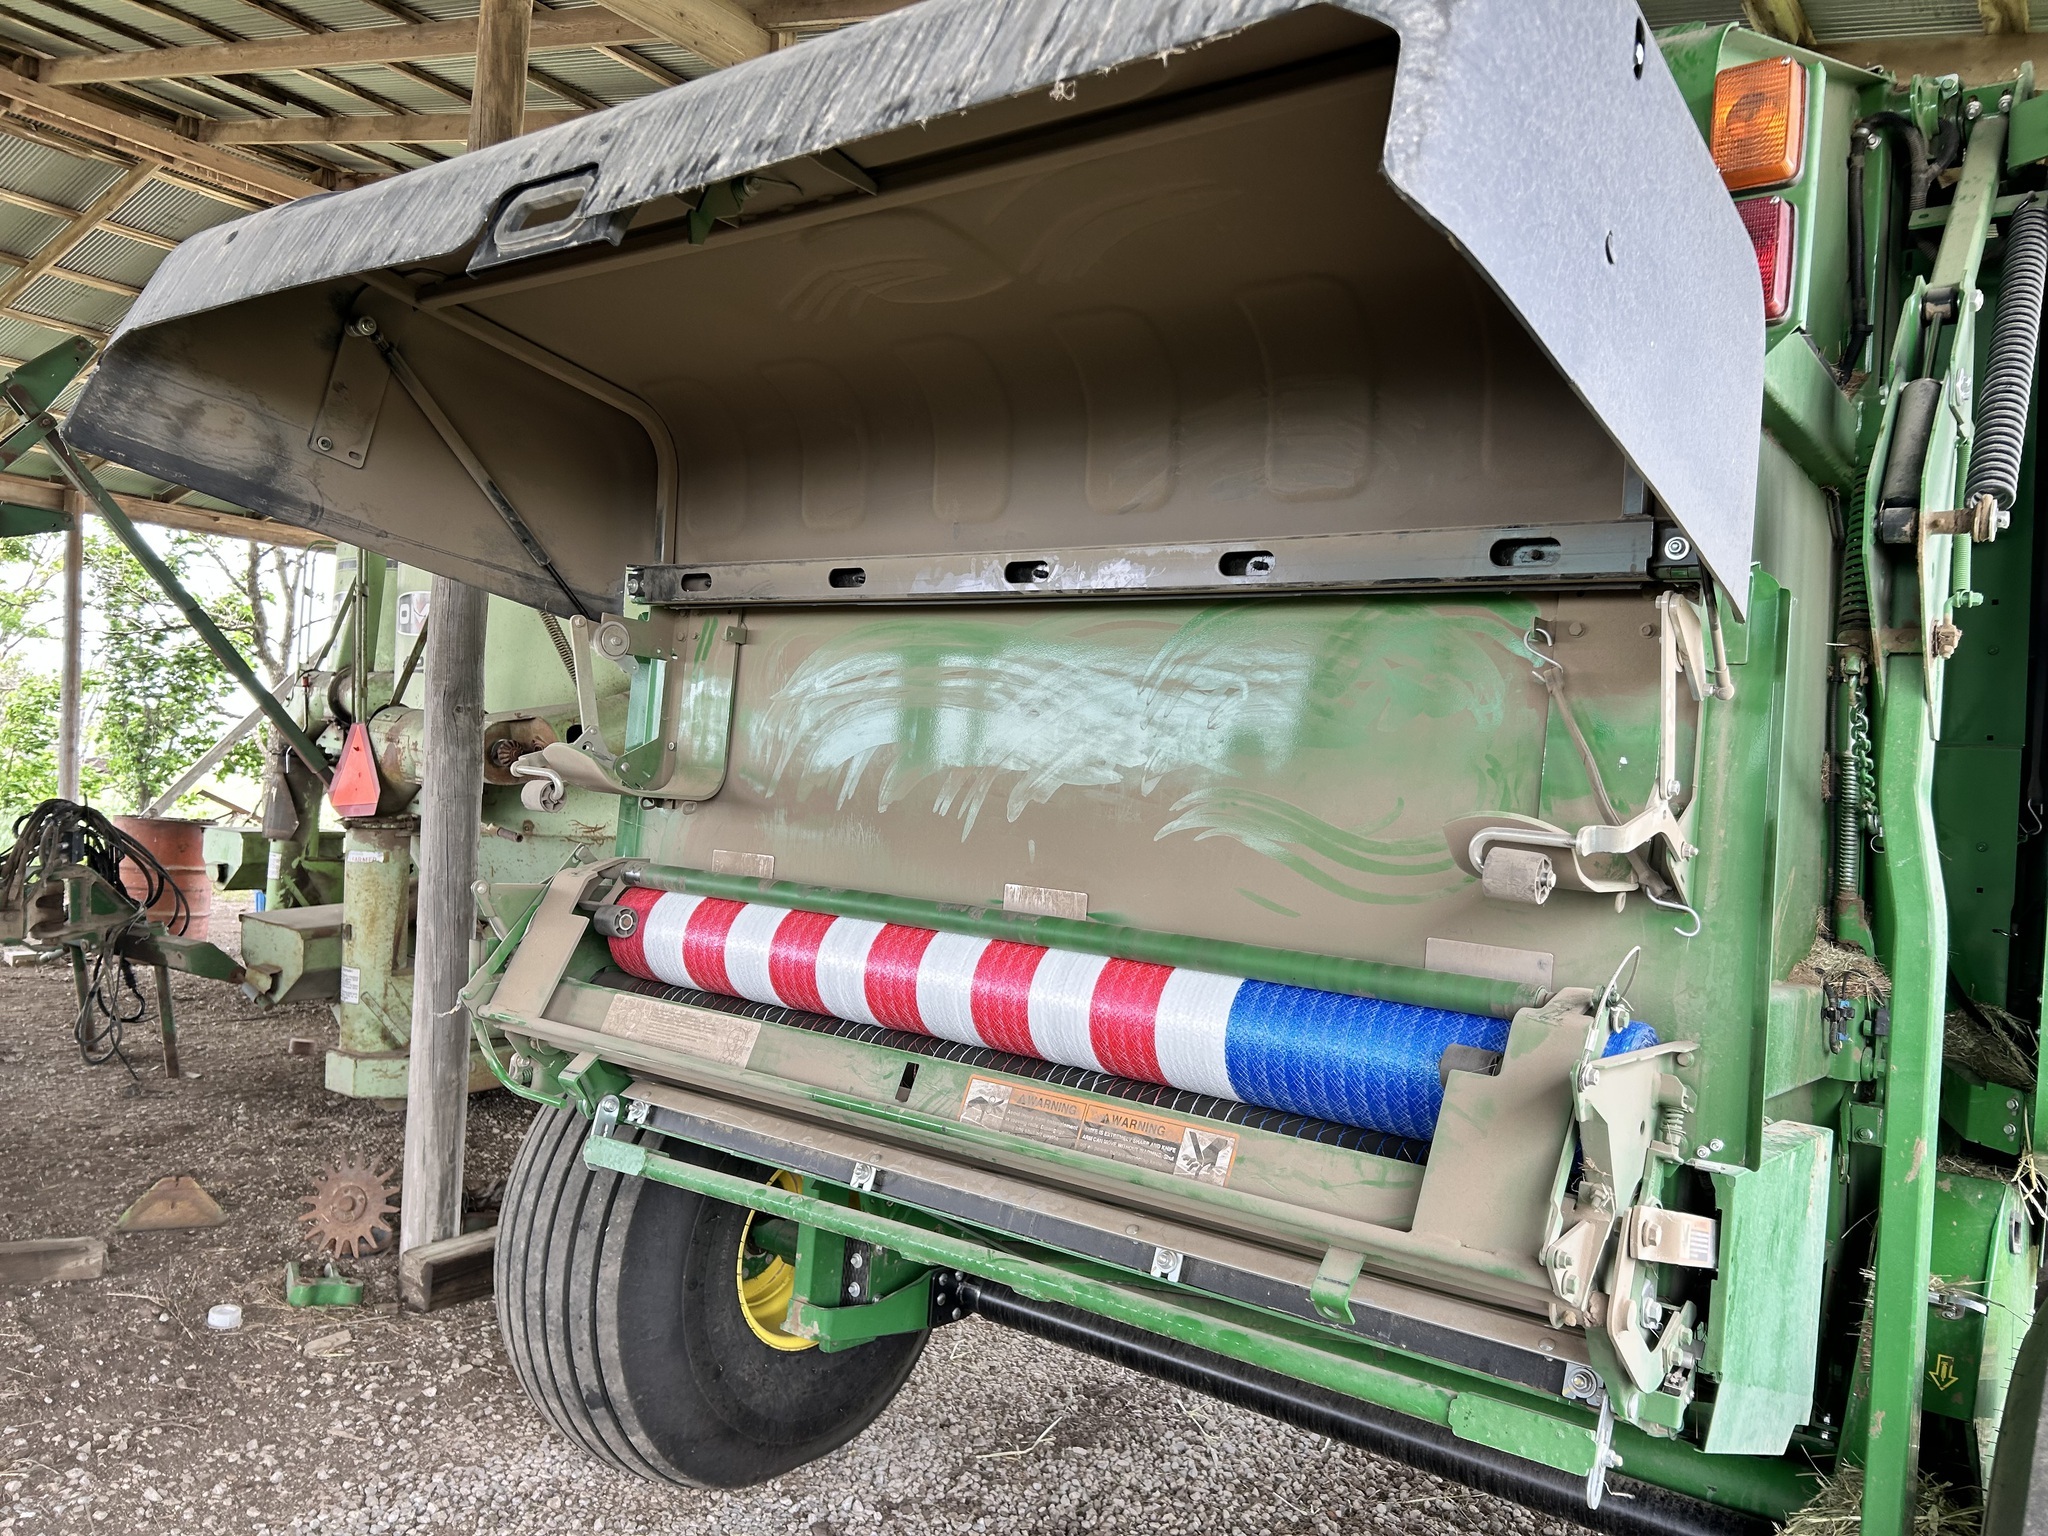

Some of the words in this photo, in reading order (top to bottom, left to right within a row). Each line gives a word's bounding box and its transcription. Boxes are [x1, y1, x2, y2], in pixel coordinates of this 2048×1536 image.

[1027, 1095, 1077, 1115] WARNING
[1111, 1114, 1166, 1136] WARNING
[1082, 1134, 1093, 1142] ARM
[1093, 1136, 1103, 1144] CAN
[1150, 1141, 1161, 1150] AND
[1161, 1144, 1177, 1153] KNIFE
